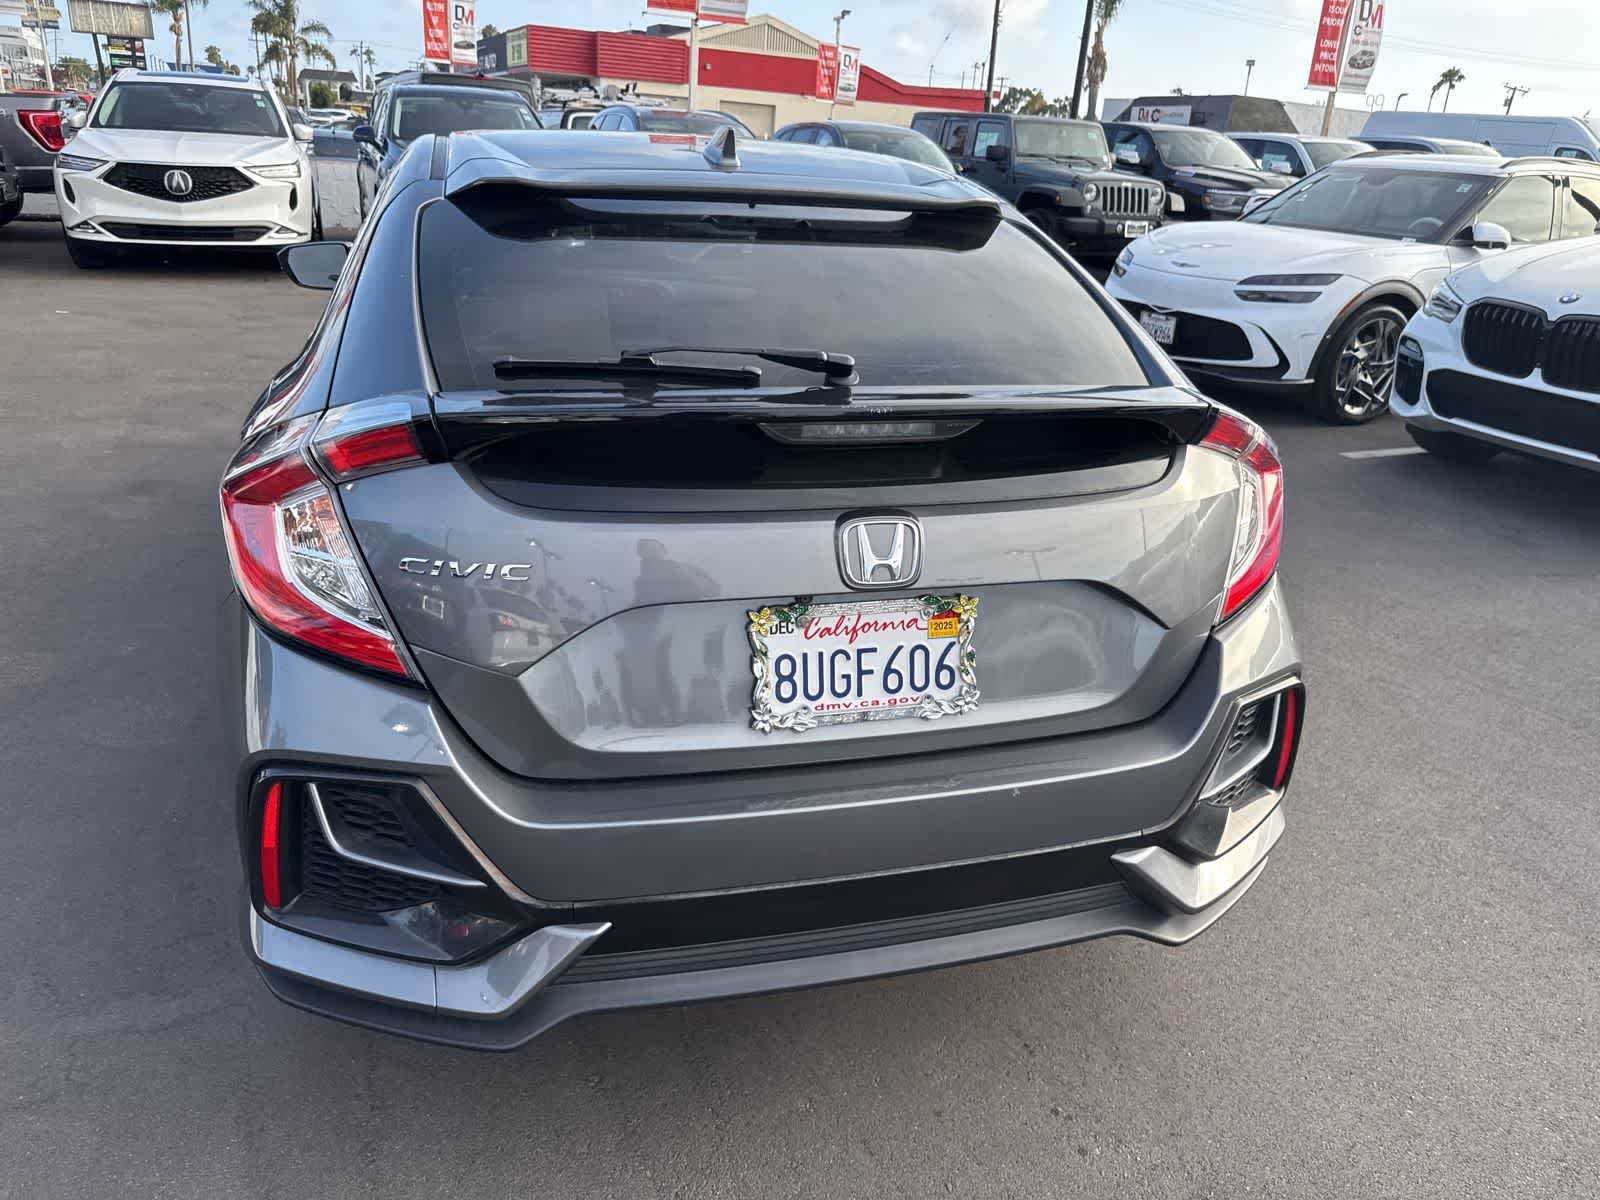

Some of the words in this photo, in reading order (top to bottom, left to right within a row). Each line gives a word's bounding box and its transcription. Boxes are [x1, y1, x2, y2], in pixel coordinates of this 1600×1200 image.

[399, 556, 533, 581] CIVIC
[769, 618, 795, 636] DEC
[802, 613, 928, 644] California
[934, 620, 953, 631] 2025
[773, 641, 957, 704] 8UGF606
[813, 694, 921, 712] dmv.ca.gov
